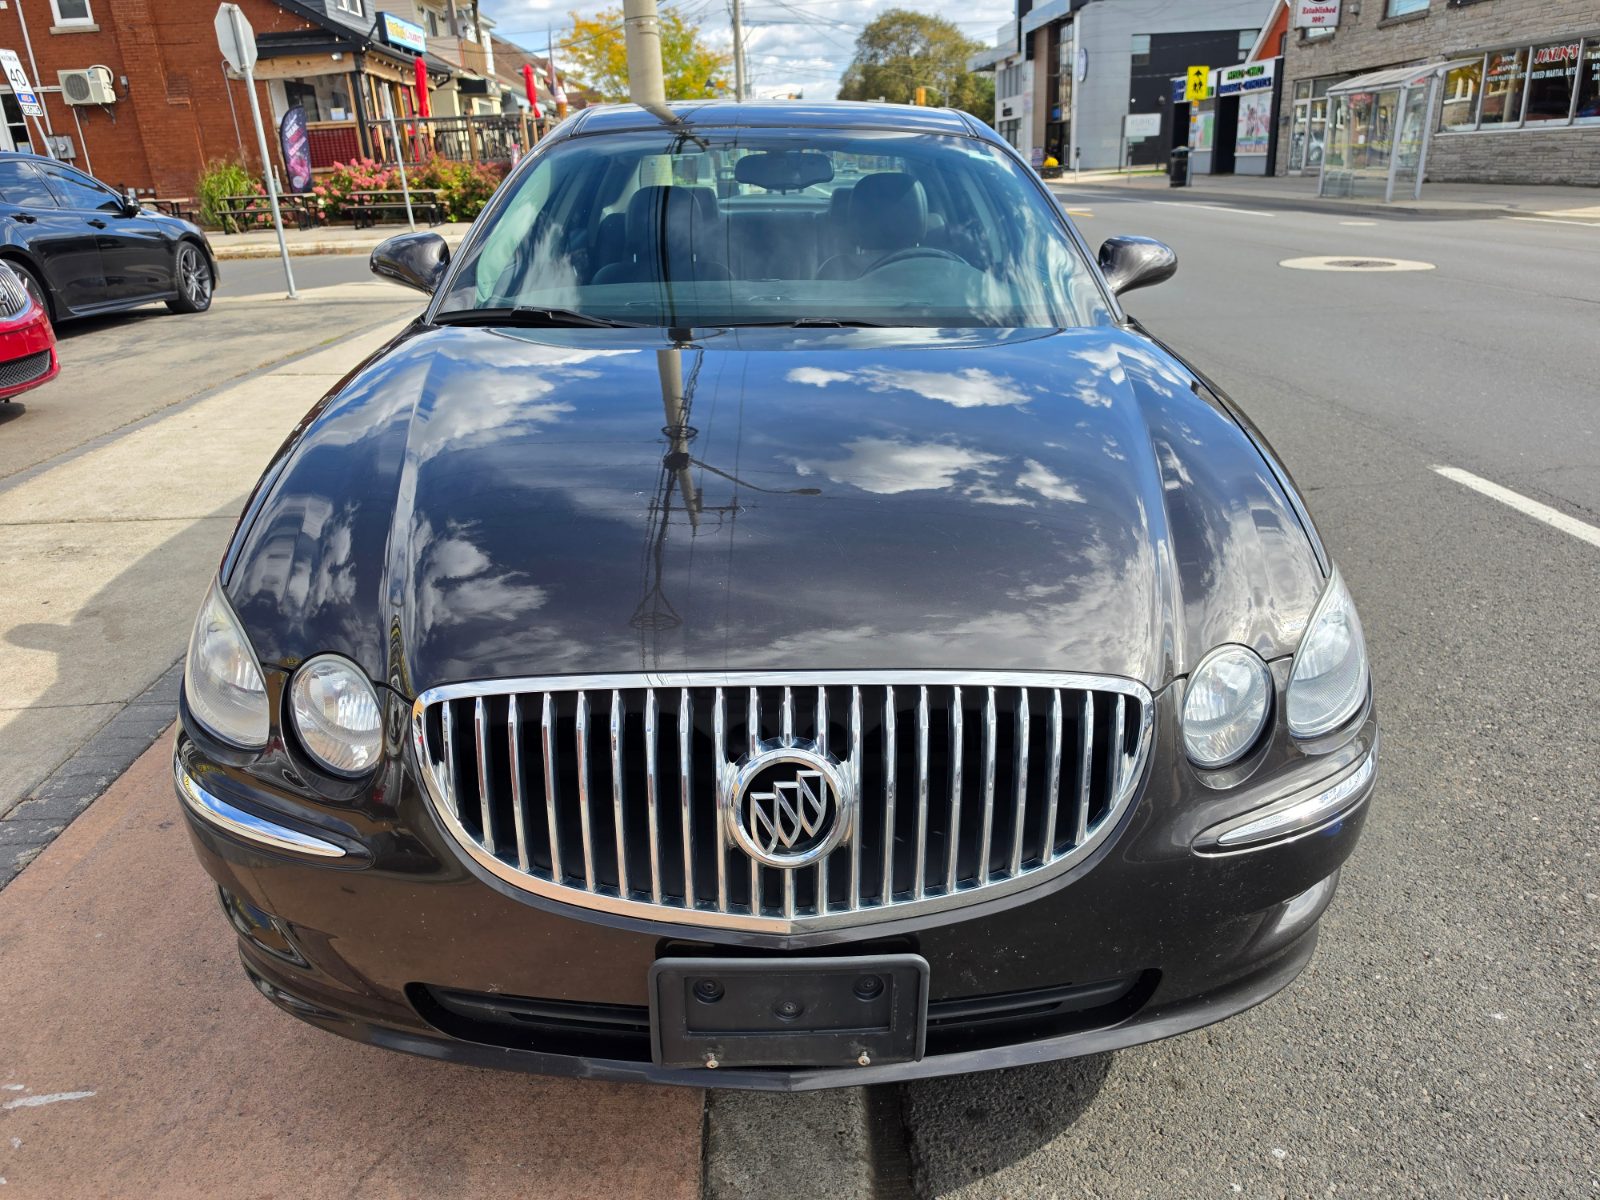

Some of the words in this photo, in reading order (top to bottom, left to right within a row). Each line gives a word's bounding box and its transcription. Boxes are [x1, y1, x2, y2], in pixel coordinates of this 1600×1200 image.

[1302, 6, 1337, 14] Established
[1534, 44, 1579, 64] JOSLIN'S
[10, 68, 26, 87] 40
[1531, 70, 1546, 79] MIXED
[1546, 68, 1564, 78] MARTIAL
[1565, 67, 1577, 76] ARTS
